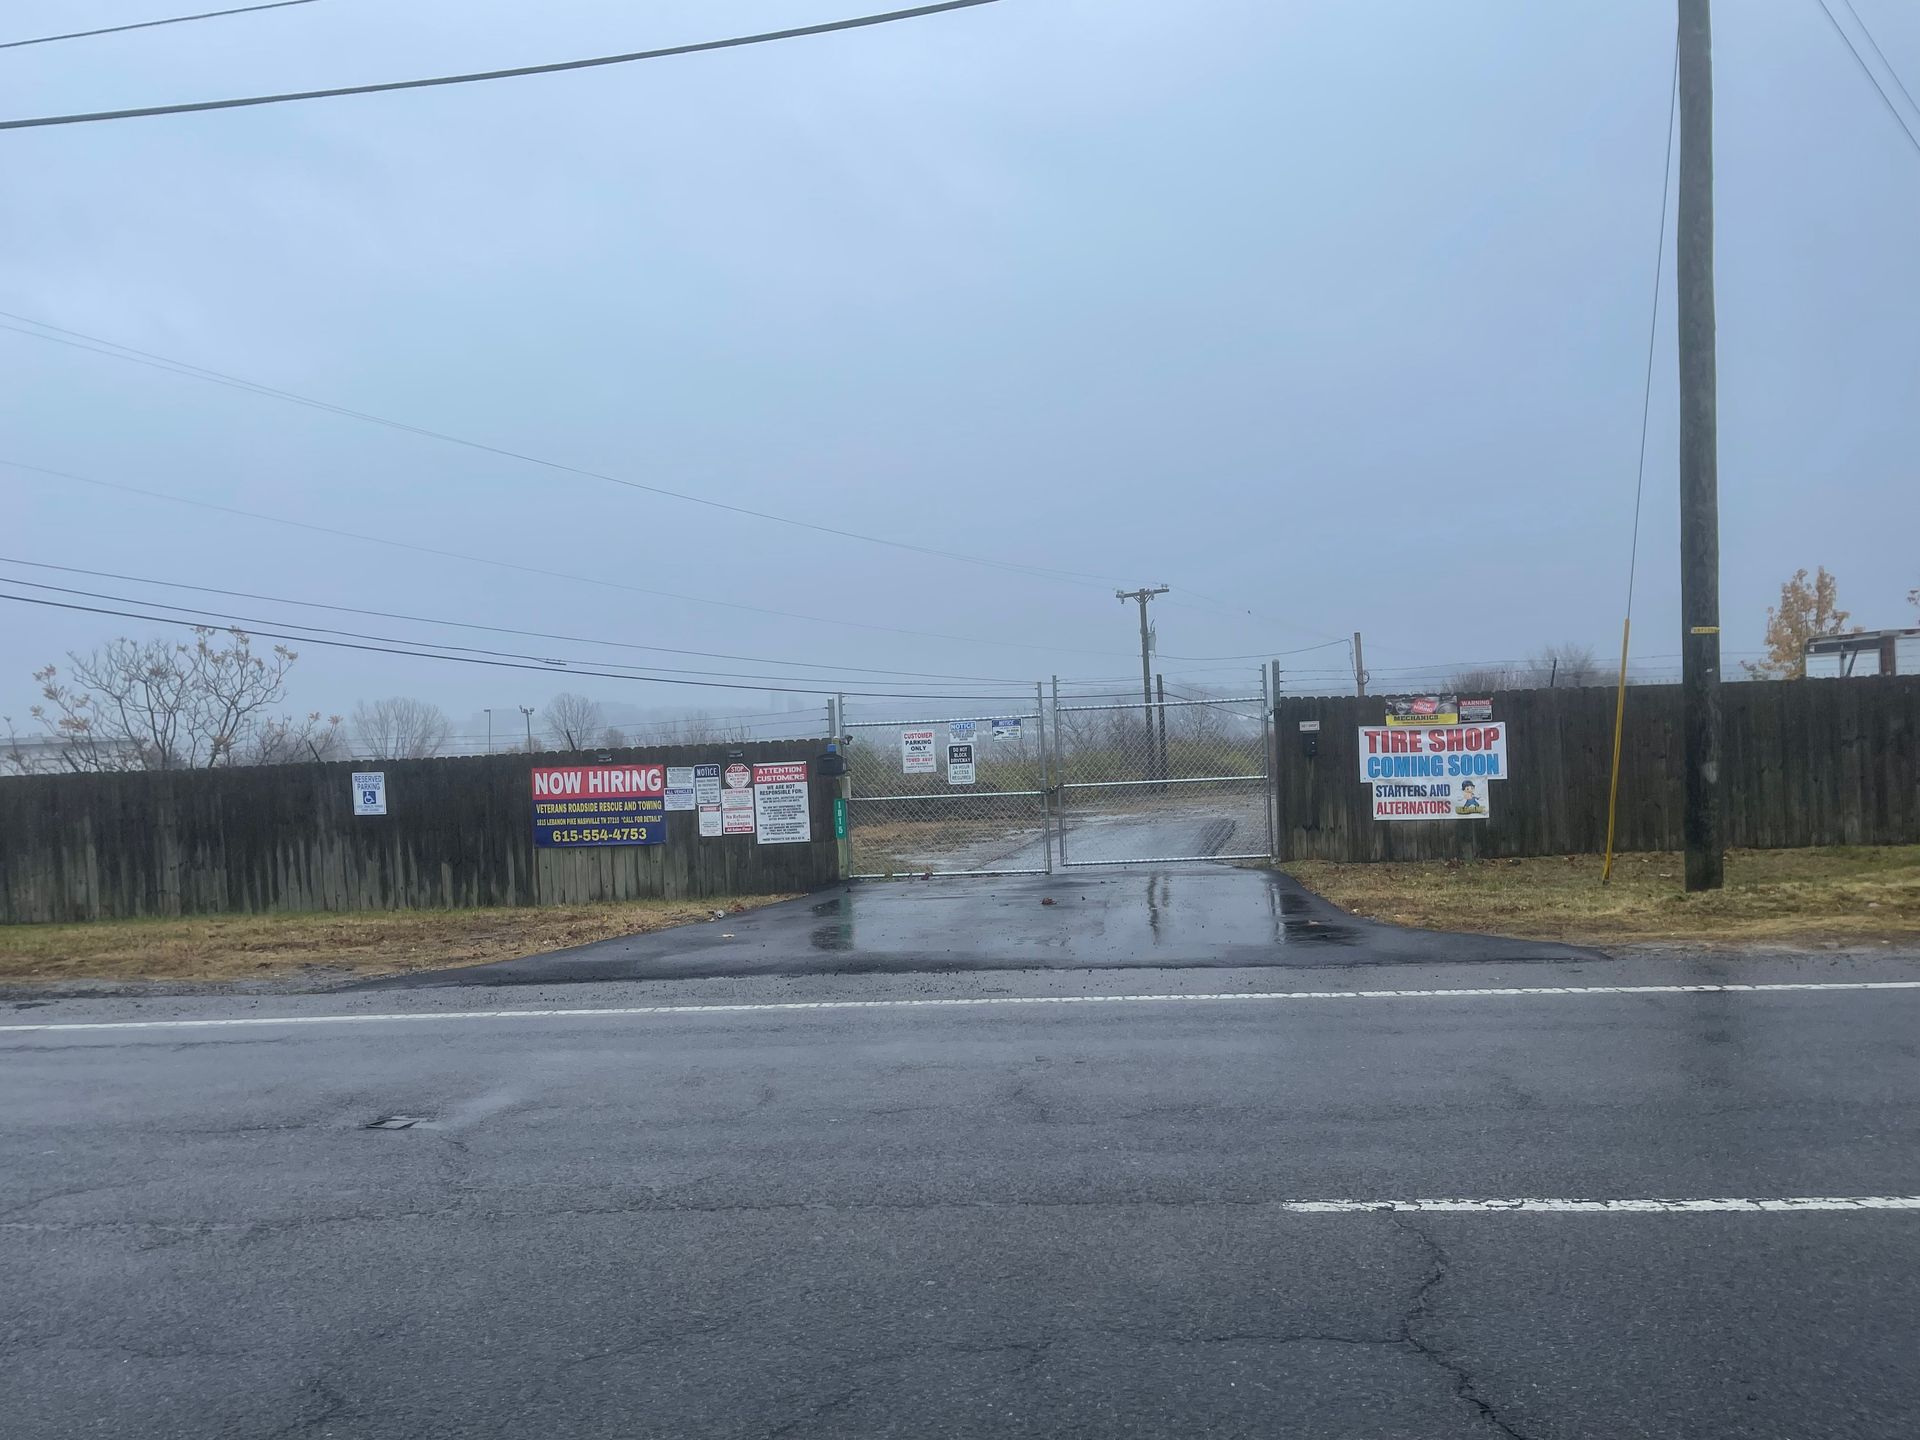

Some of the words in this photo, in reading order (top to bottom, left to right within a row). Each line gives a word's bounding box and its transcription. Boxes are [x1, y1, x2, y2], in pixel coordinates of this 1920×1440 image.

[1364, 730, 1422, 754] TIRE
[1428, 727, 1500, 752] SHOP
[697, 767, 717, 776] NOTICE
[759, 766, 802, 774] ATTENTION
[1367, 755, 1444, 778] COMING
[1447, 753, 1500, 777] SOON
[535, 772, 582, 795] NOW
[589, 769, 662, 793] HIRING
[757, 774, 805, 782] CUSTOMERS
[1376, 784, 1427, 798] STARTERS
[1429, 784, 1450, 797] AND
[536, 803, 568, 814] VETERANS
[568, 802, 597, 813] ROADSIDE
[599, 801, 623, 812] RESCUE
[624, 801, 637, 811] AND
[638, 800, 662, 810] TOWING
[1376, 800, 1451, 815] ALTERNATORS
[552, 828, 647, 842] 615-554-4753
